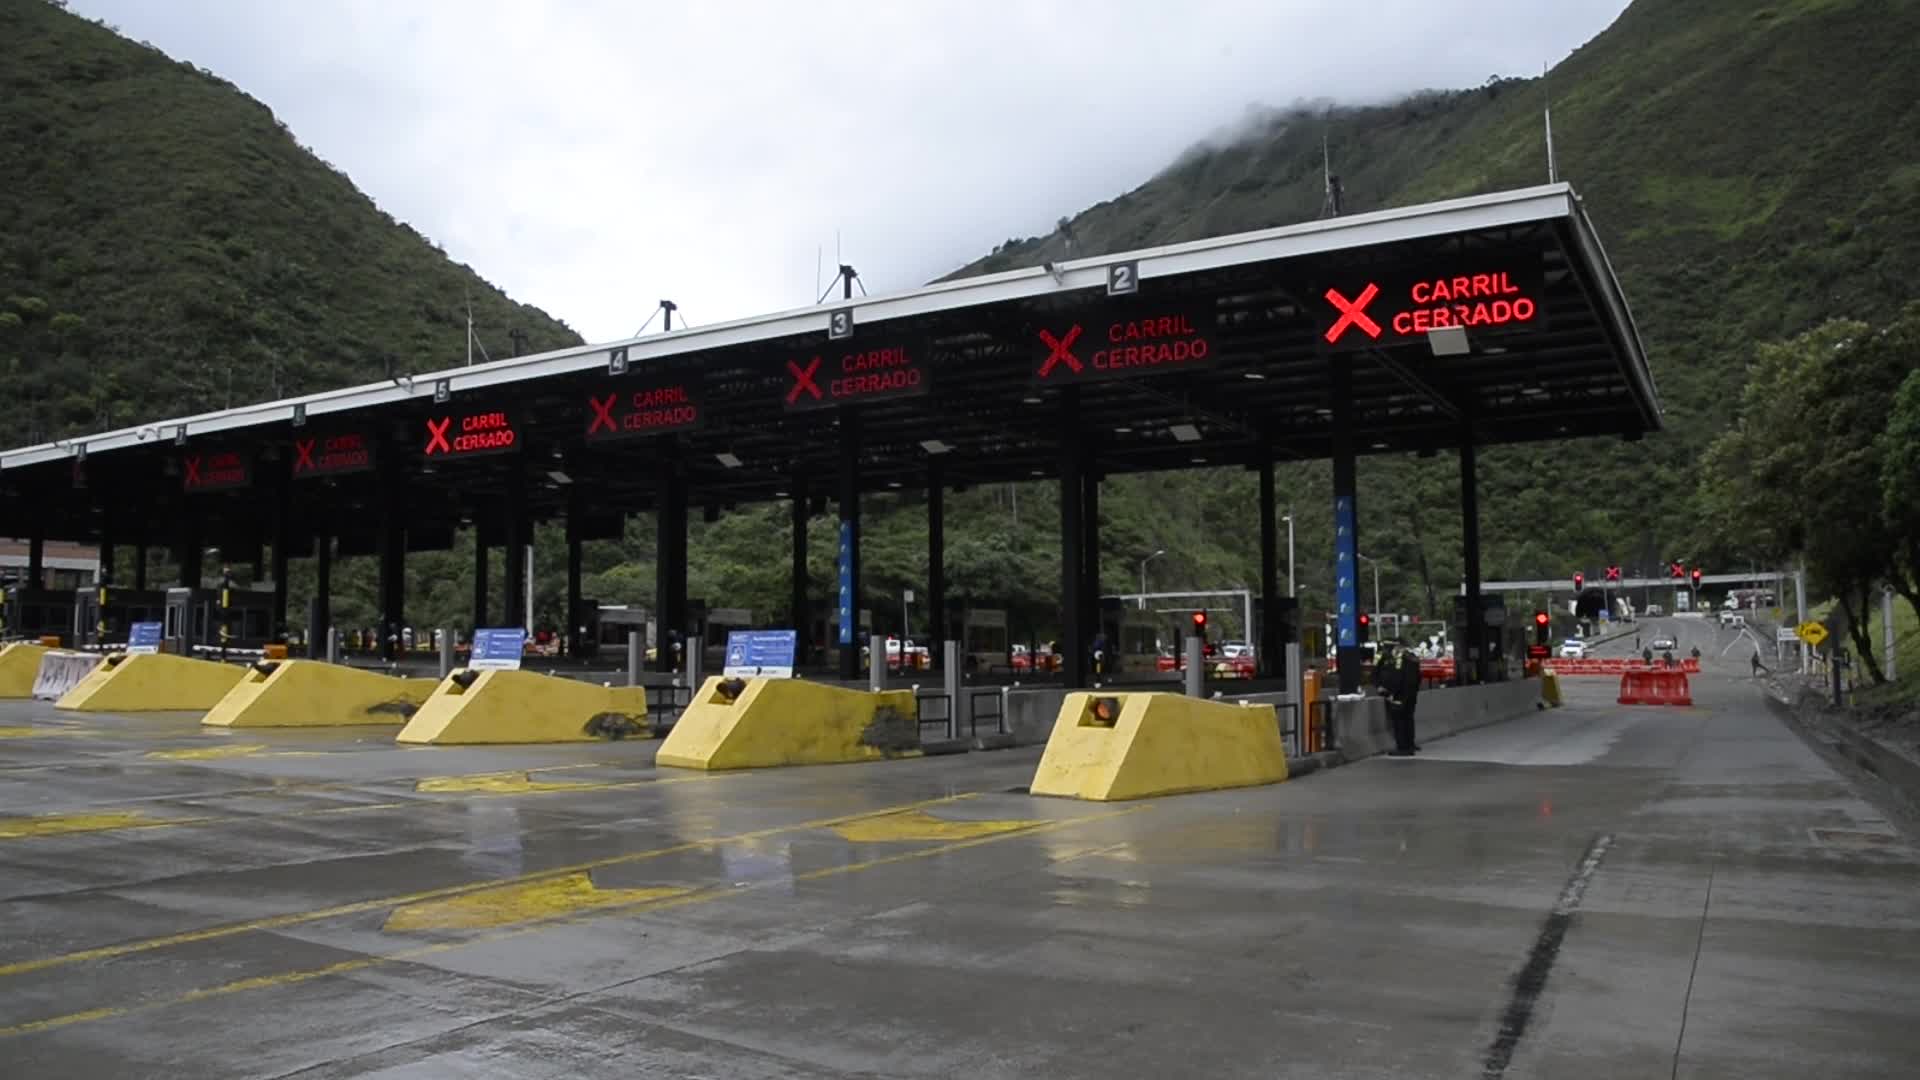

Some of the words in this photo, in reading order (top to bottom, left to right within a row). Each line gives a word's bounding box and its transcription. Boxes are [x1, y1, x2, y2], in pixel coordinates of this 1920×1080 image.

[1113, 266, 1130, 290] 2
[1411, 272, 1519, 303] CARRIL
[834, 313, 846, 333] 3
[1393, 297, 1535, 334] CERRADO
[1108, 315, 1194, 342] CARRIL
[613, 351, 624, 369] 4
[842, 347, 910, 371] CARRIL
[1093, 339, 1207, 370] CERRADO
[438, 381, 447, 398] 5
[831, 369, 920, 396] CERRADO
[633, 386, 687, 409] CARRIL
[462, 412, 509, 431] CARRIL
[623, 406, 696, 429] CERRADO
[454, 430, 515, 452] CERRADO
